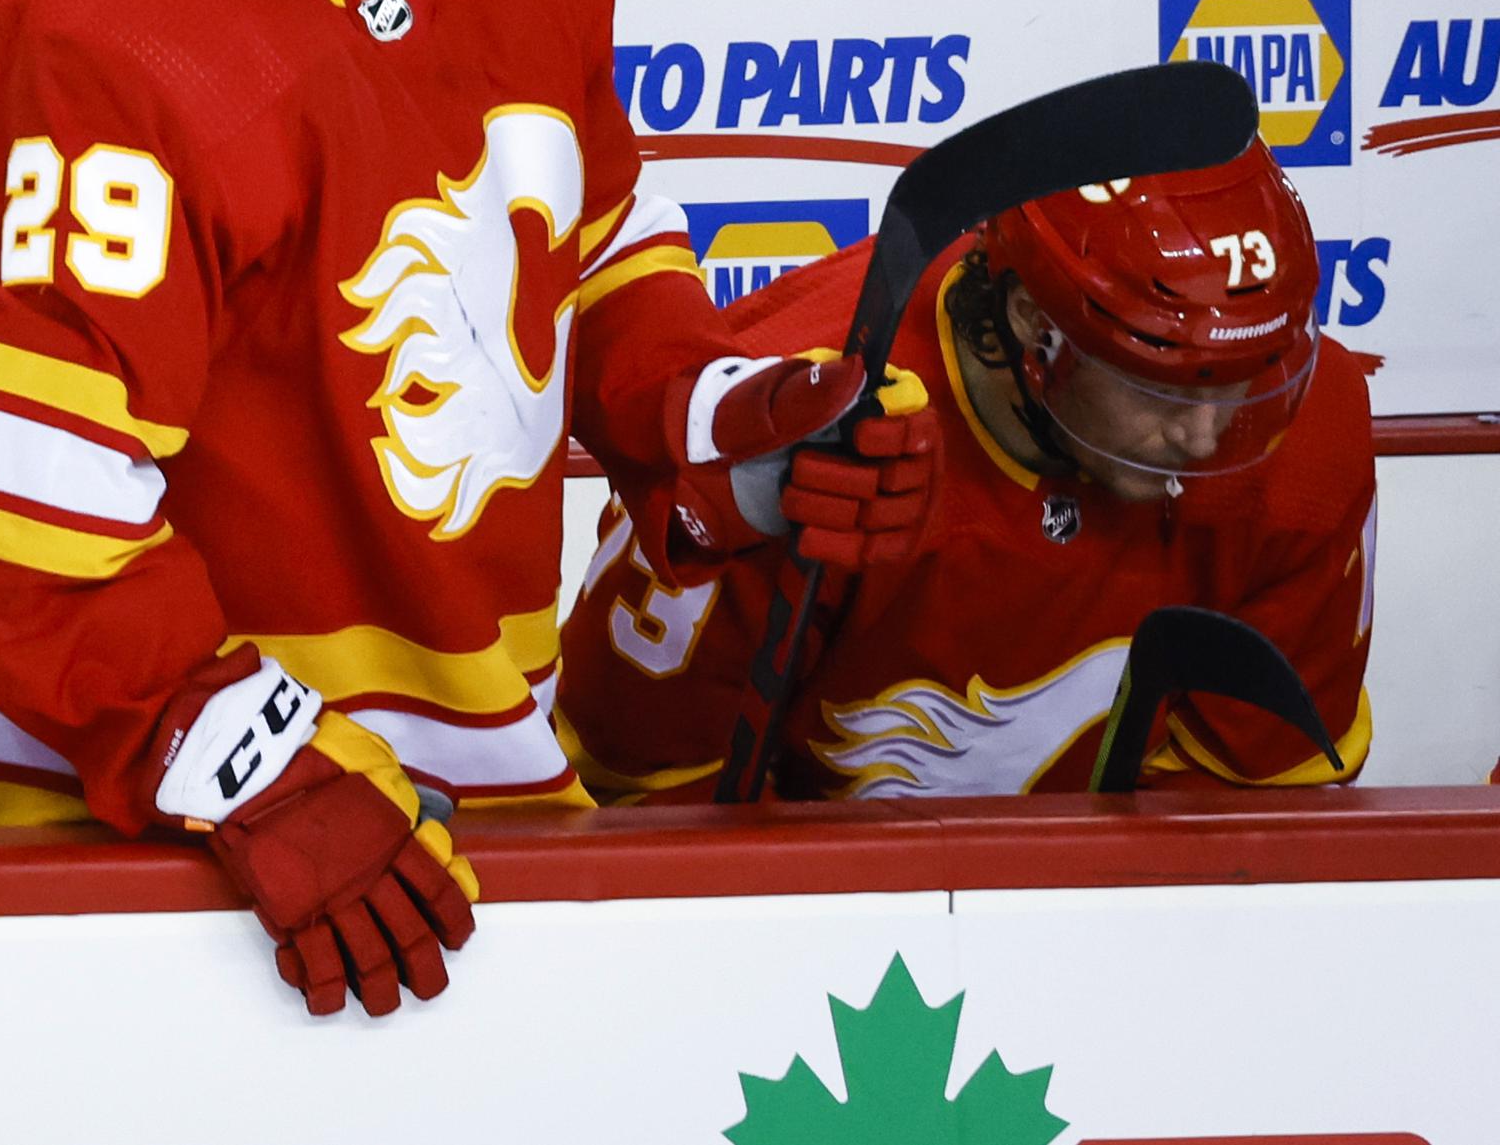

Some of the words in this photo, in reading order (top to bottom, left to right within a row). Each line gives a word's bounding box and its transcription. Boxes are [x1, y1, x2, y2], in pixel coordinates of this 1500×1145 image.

[716, 35, 971, 129] PARTS
[1, 135, 175, 299] 29
[1209, 230, 1277, 287] 73
[216, 677, 310, 800] CC
